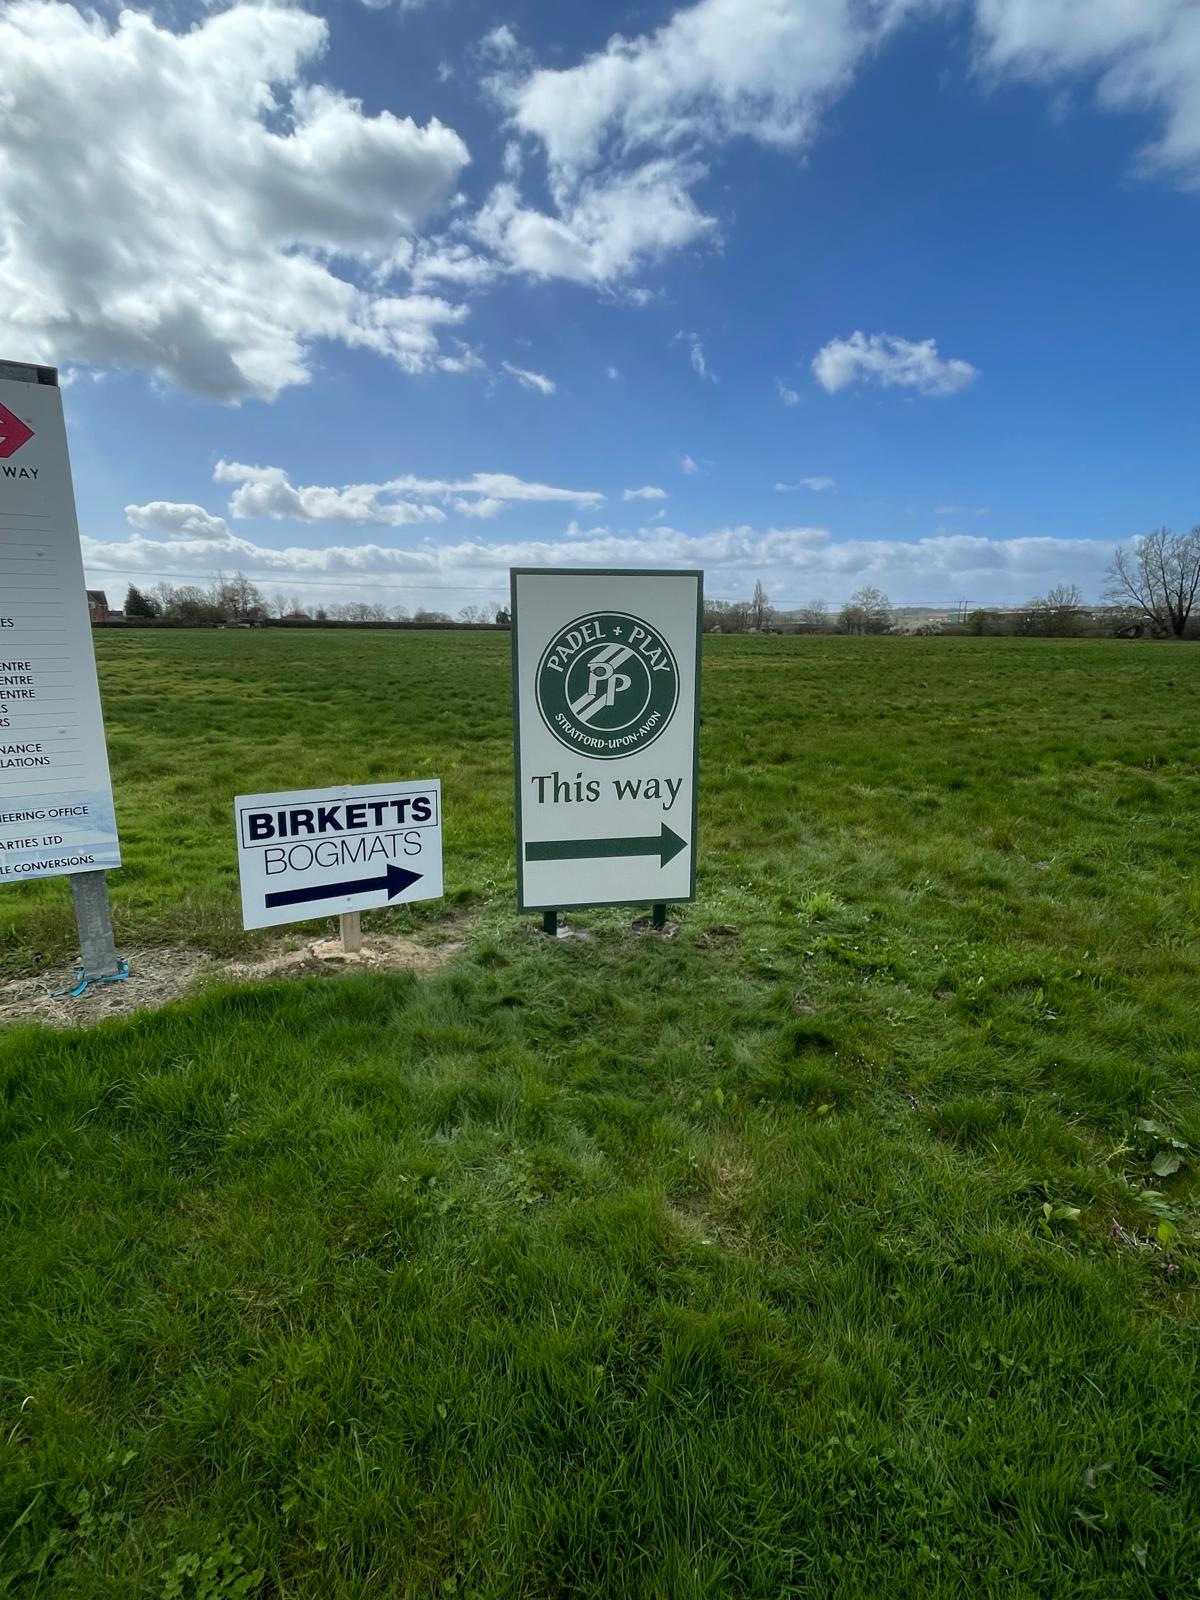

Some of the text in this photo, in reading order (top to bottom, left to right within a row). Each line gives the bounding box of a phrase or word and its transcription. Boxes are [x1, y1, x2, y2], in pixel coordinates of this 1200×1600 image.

[2, 466, 39, 480] WAY
[547, 620, 606, 673] PADEL
[627, 625, 671, 672] PLAY
[555, 710, 662, 749] STRATFORD-UPON-AVON
[531, 771, 683, 811] This way
[0, 805, 89, 823] EERING OFFICE
[248, 797, 432, 841] BIRKETTS
[42, 835, 63, 846] LTD
[264, 830, 423, 876] BOGMATS
[14, 855, 95, 873] CONVERSIONS
